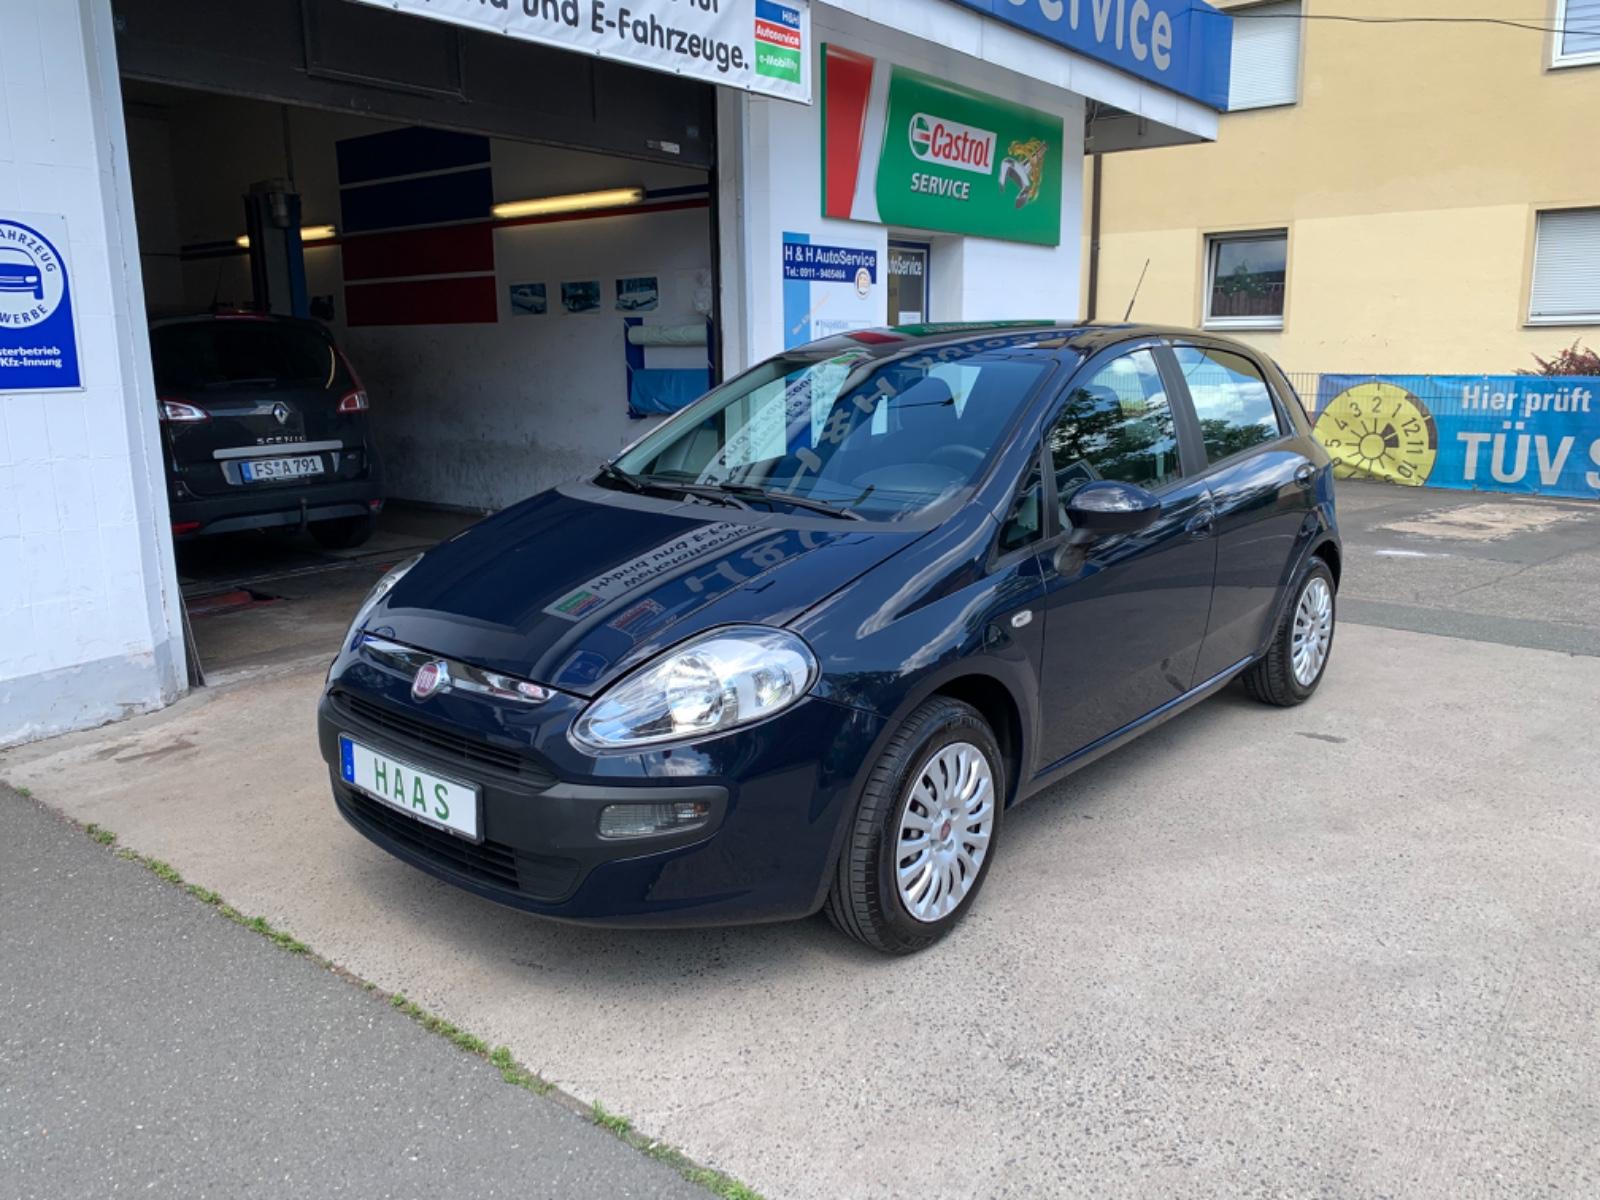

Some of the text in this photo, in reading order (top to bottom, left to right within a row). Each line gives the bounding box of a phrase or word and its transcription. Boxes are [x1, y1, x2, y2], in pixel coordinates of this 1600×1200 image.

[523, 0, 749, 73] und E-Fahrzeuge.
[931, 123, 991, 167] Castrol
[911, 172, 971, 200] SERVICE
[785, 246, 876, 268] H & H AutoService
[1, 357, 62, 368] Kfz-Innung
[1350, 402, 1362, 418] 3
[1372, 396, 1382, 413] 2
[1462, 385, 1592, 418] Hier prüft
[1335, 418, 1349, 431] 4
[1401, 417, 1421, 437] 12
[1325, 439, 1342, 448] 5
[1406, 440, 1424, 454] 11
[1457, 421, 1575, 486] TÜV
[255, 462, 274, 478] FS
[1397, 460, 1418, 478] 10
[374, 757, 450, 821] HAAS
